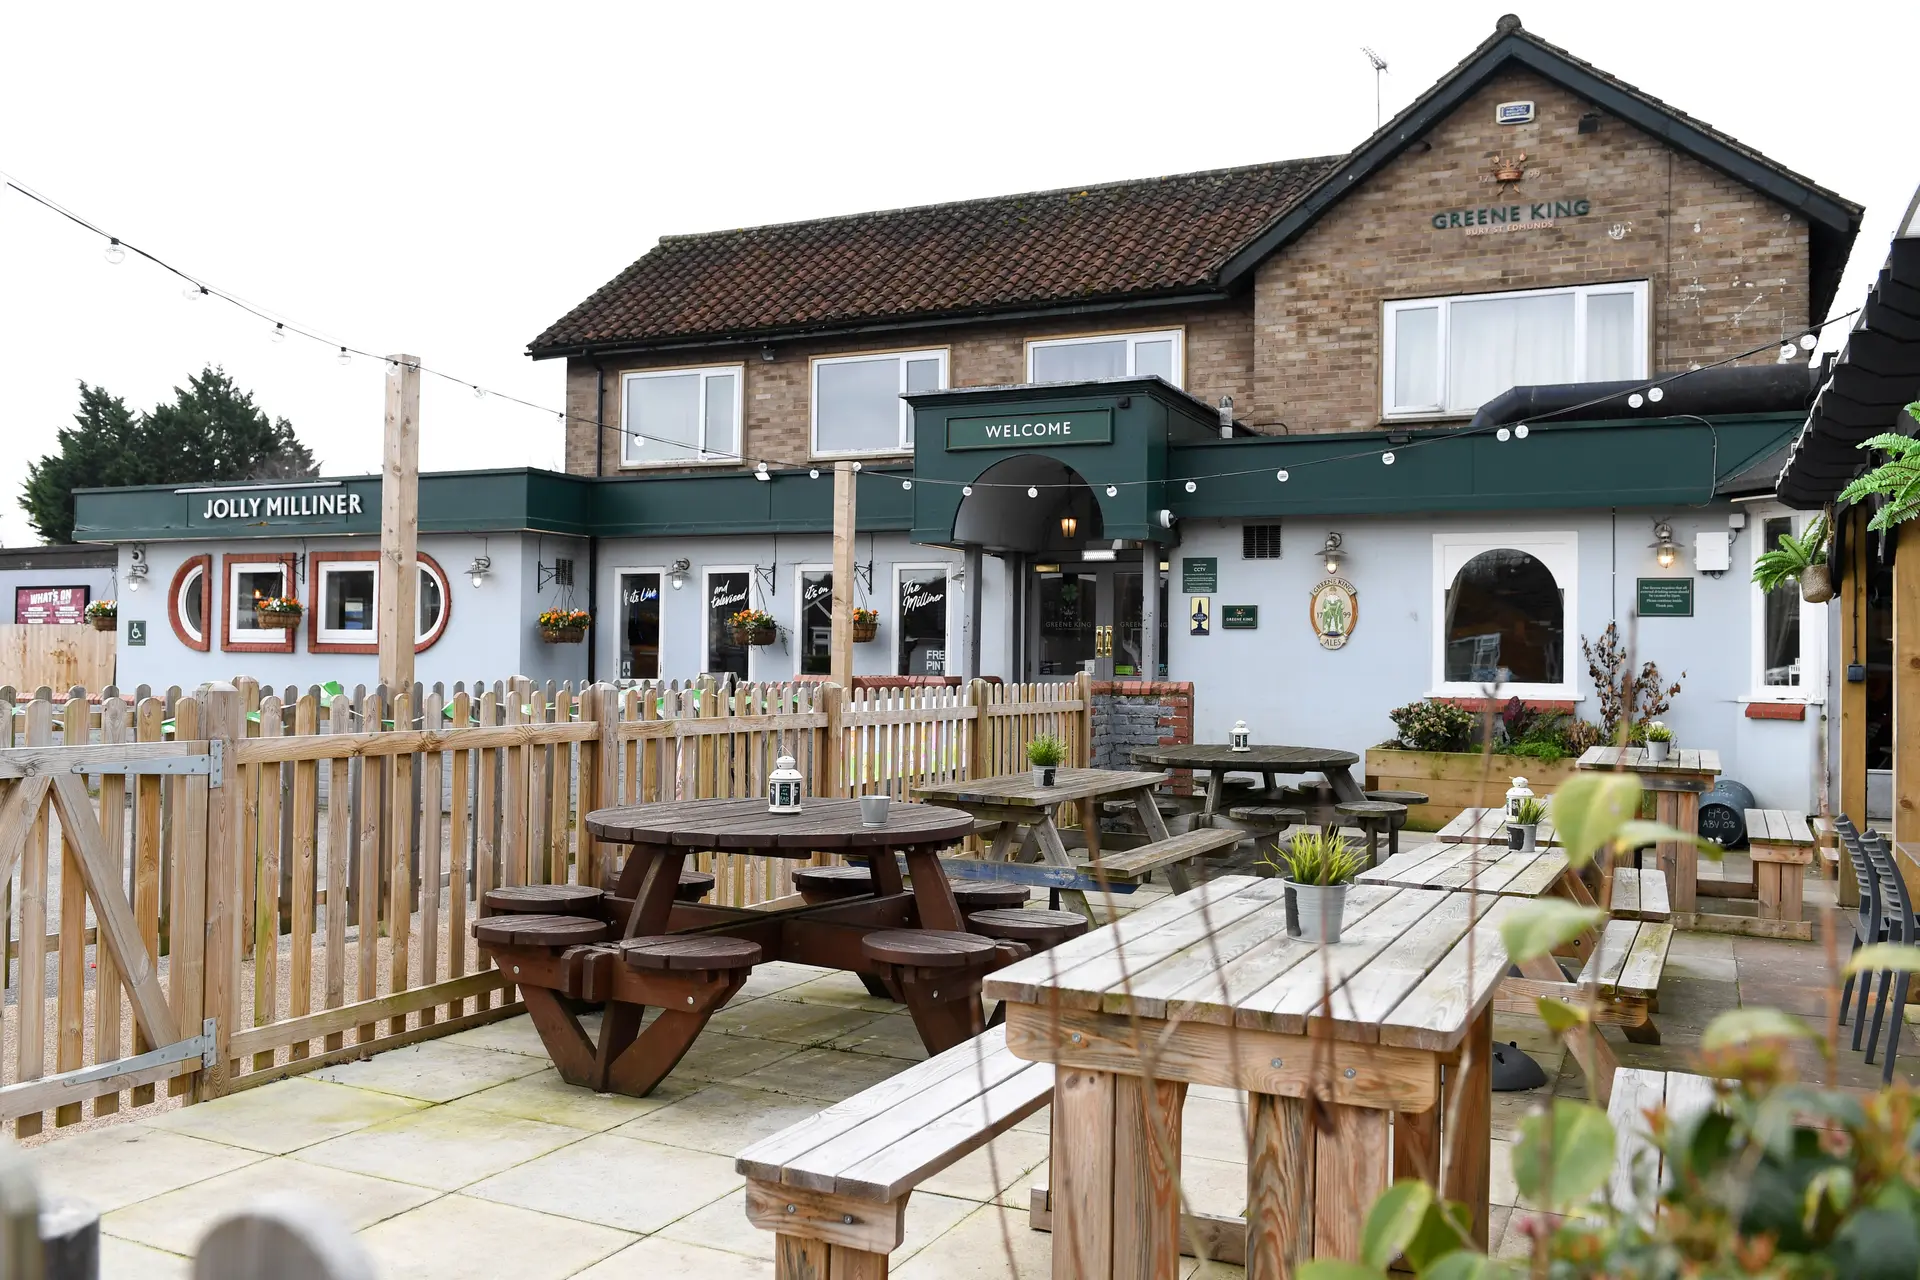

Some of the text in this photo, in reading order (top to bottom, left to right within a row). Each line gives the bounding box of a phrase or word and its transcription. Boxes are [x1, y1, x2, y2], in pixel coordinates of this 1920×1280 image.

[1432, 199, 1591, 230] GREENE KING
[1465, 221, 1553, 236] BURY ST EDMUNDS
[985, 421, 1071, 438] WELCOME
[203, 494, 363, 519] JOLLY MILLINER
[713, 580, 730, 595] and
[818, 586, 829, 595] on
[902, 578, 922, 596] The
[1313, 579, 1353, 593] GREENE KING
[30, 588, 72, 605] WHAT'S ON
[640, 588, 658, 602] Live
[711, 587, 748, 609] televised
[902, 592, 944, 616] Milliner
[926, 650, 945, 660] FRE
[1702, 820, 1736, 829] ABV 0%
